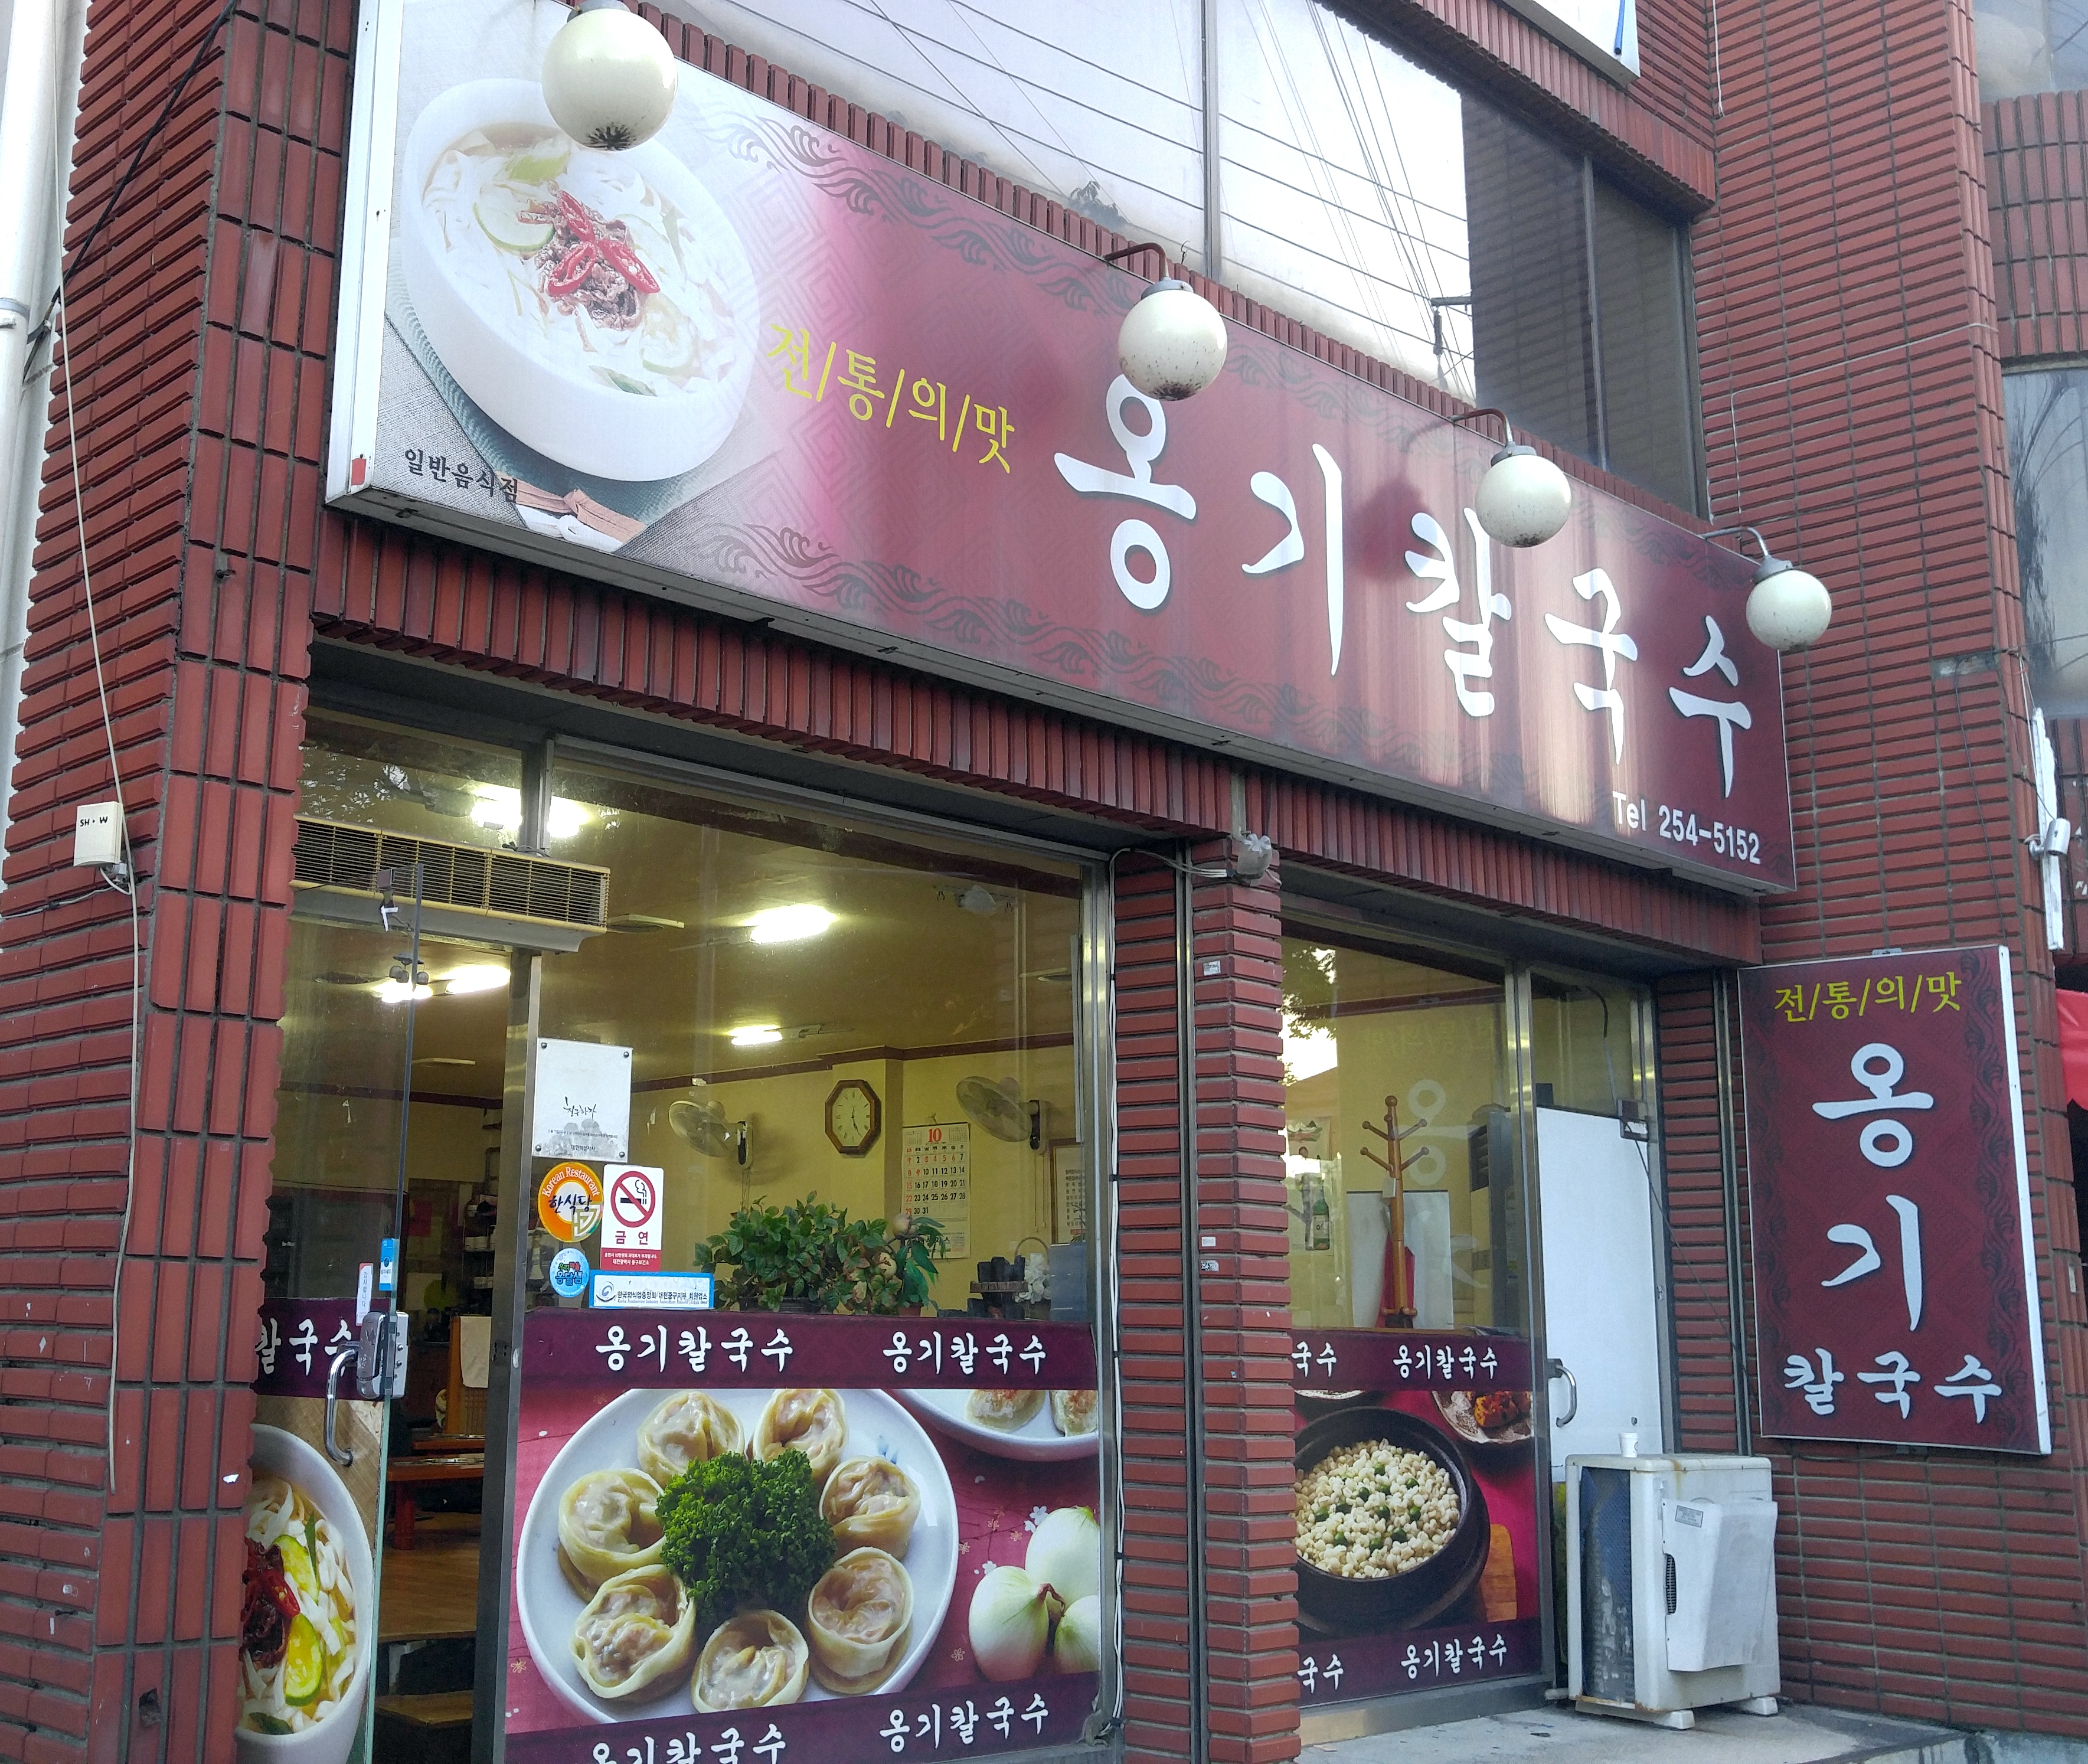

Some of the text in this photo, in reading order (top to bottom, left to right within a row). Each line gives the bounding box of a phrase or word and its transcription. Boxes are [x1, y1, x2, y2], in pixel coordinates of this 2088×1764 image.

[405, 449, 518, 504] 일반음식점
[1054, 374, 1753, 799] 옹기칼국수
[1612, 790, 1761, 865] Tel 254-5152
[928, 1128, 942, 1143] 10
[542, 1167, 600, 1198] Korean Restaurant
[548, 1194, 593, 1216] 한식당
[555, 1270, 583, 1286] 옹달샘
[658, 1292, 687, 1301] 대전중구지부
[688, 1292, 708, 1301] 회원업소
[596, 1325, 793, 1373] 옹기칼국수
[883, 1331, 1046, 1374] 옹기칼국수
[1393, 1344, 1498, 1380] 옹기칼국수
[1401, 1634, 1507, 1679] 옹기칼국수
[879, 1693, 1049, 1753] 옹기칼국수
